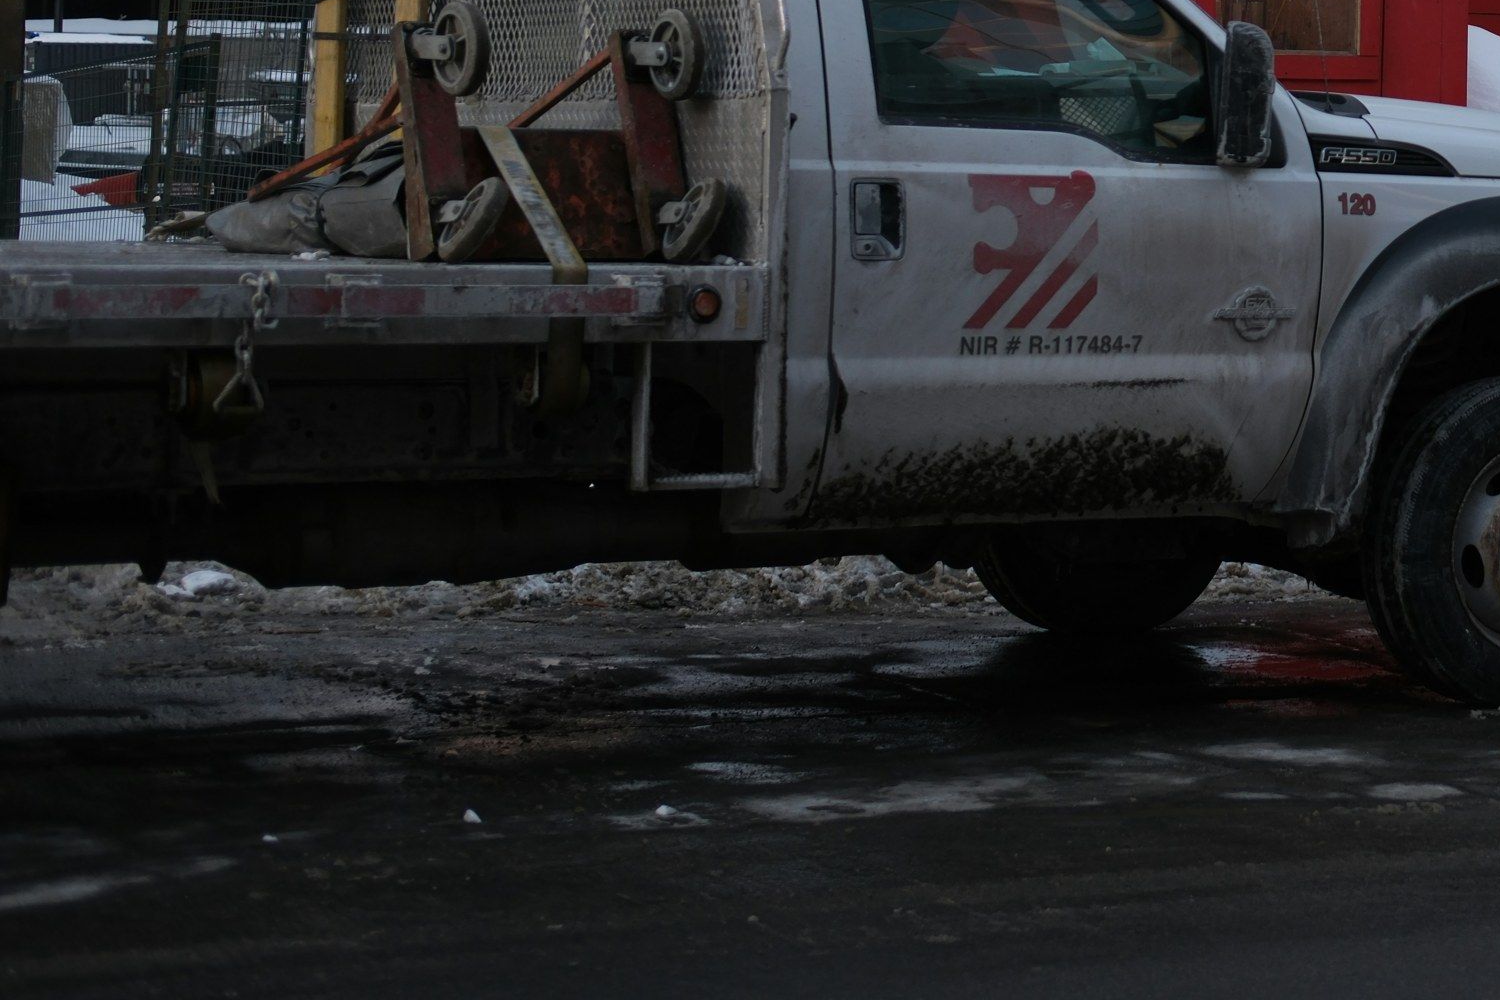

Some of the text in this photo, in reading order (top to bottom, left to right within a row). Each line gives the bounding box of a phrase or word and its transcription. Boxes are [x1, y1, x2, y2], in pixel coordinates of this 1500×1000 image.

[1320, 146, 1397, 165] F-550
[1338, 192, 1376, 217] 120
[959, 335, 1143, 355] NIR # R-117484-7
